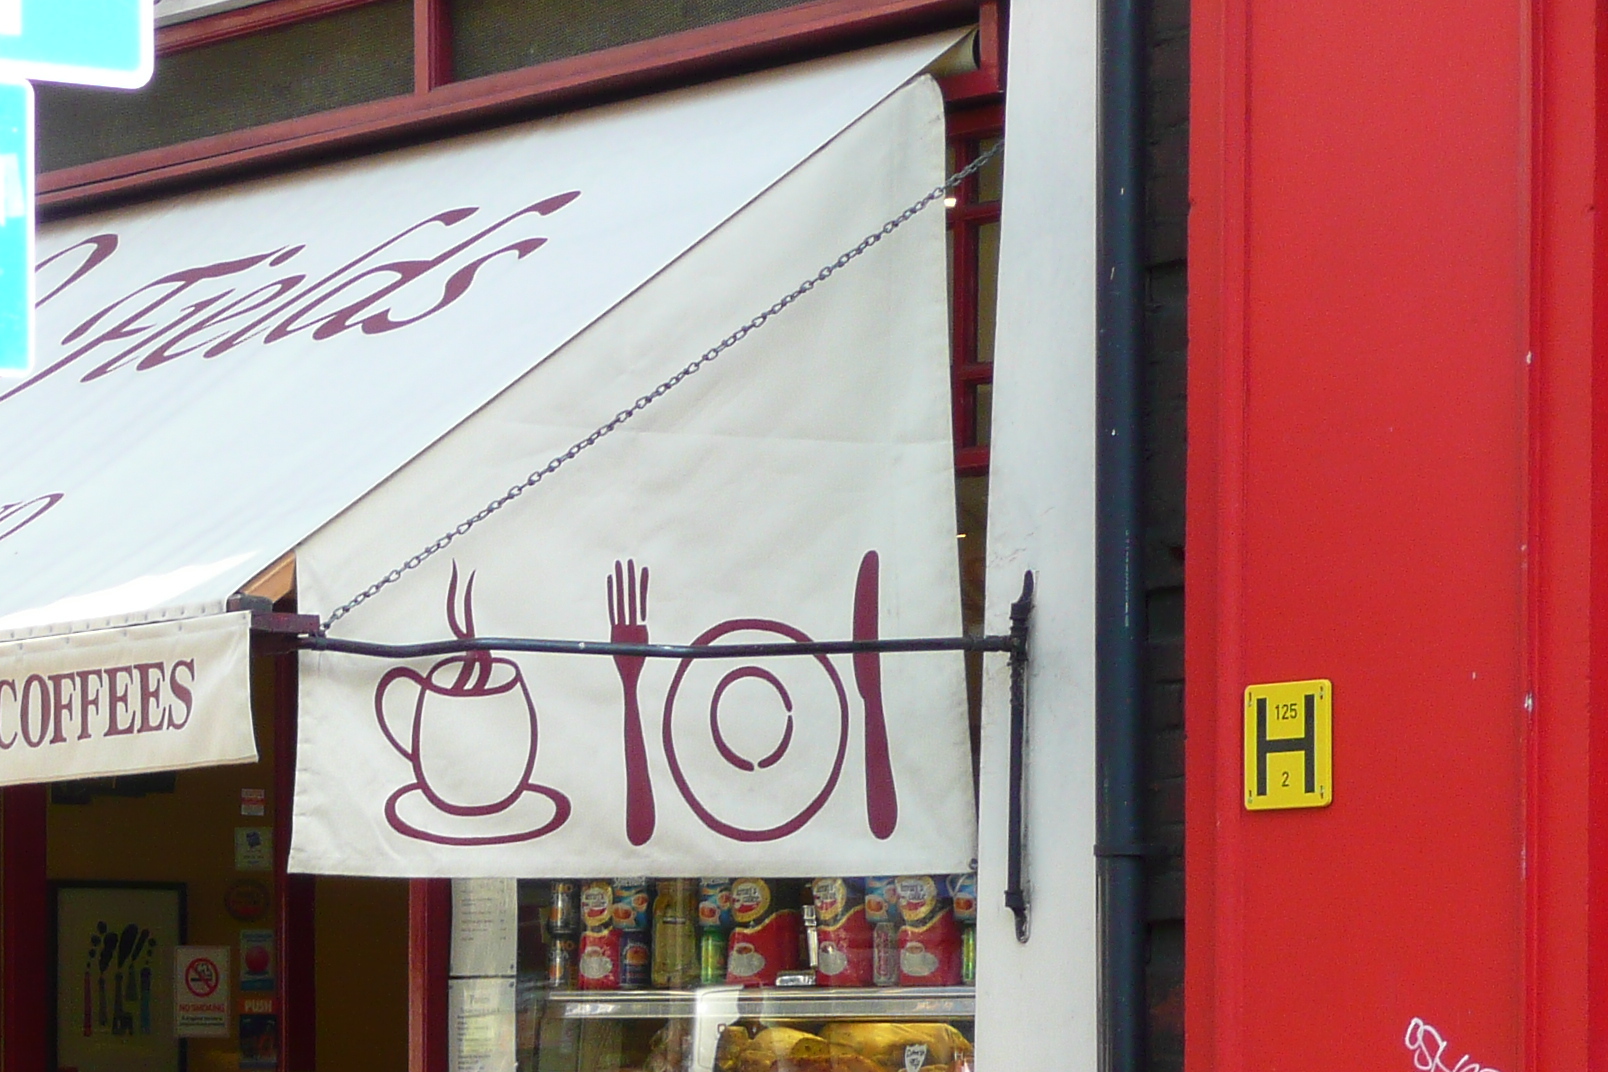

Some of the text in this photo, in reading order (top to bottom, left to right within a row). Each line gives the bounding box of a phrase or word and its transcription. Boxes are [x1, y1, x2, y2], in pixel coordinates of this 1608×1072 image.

[61, 189, 582, 384] Fields
[1274, 703, 1298, 720] 125
[1256, 693, 1316, 797] H
[1281, 771, 1290, 787] 2
[244, 999, 272, 1013] PUSH
